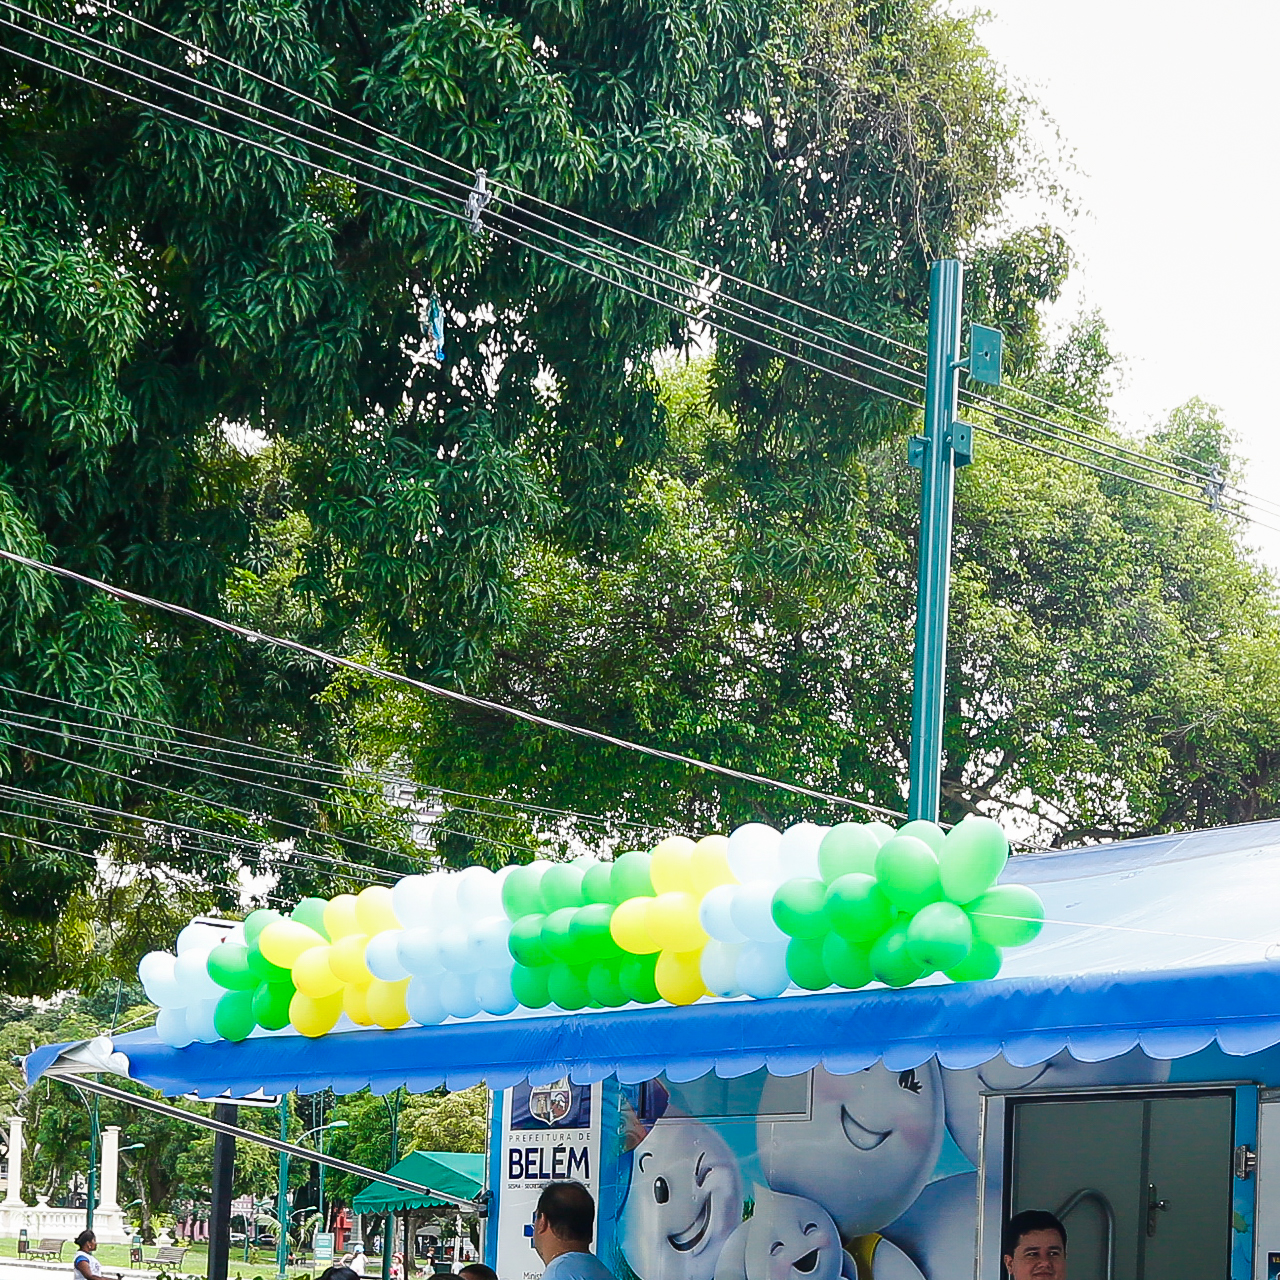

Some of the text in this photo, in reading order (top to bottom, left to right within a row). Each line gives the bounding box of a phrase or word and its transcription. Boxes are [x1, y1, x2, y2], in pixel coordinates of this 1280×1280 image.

[508, 1132, 591, 1142] PREFEITURA DE
[508, 1142, 590, 1180] BELÉM
